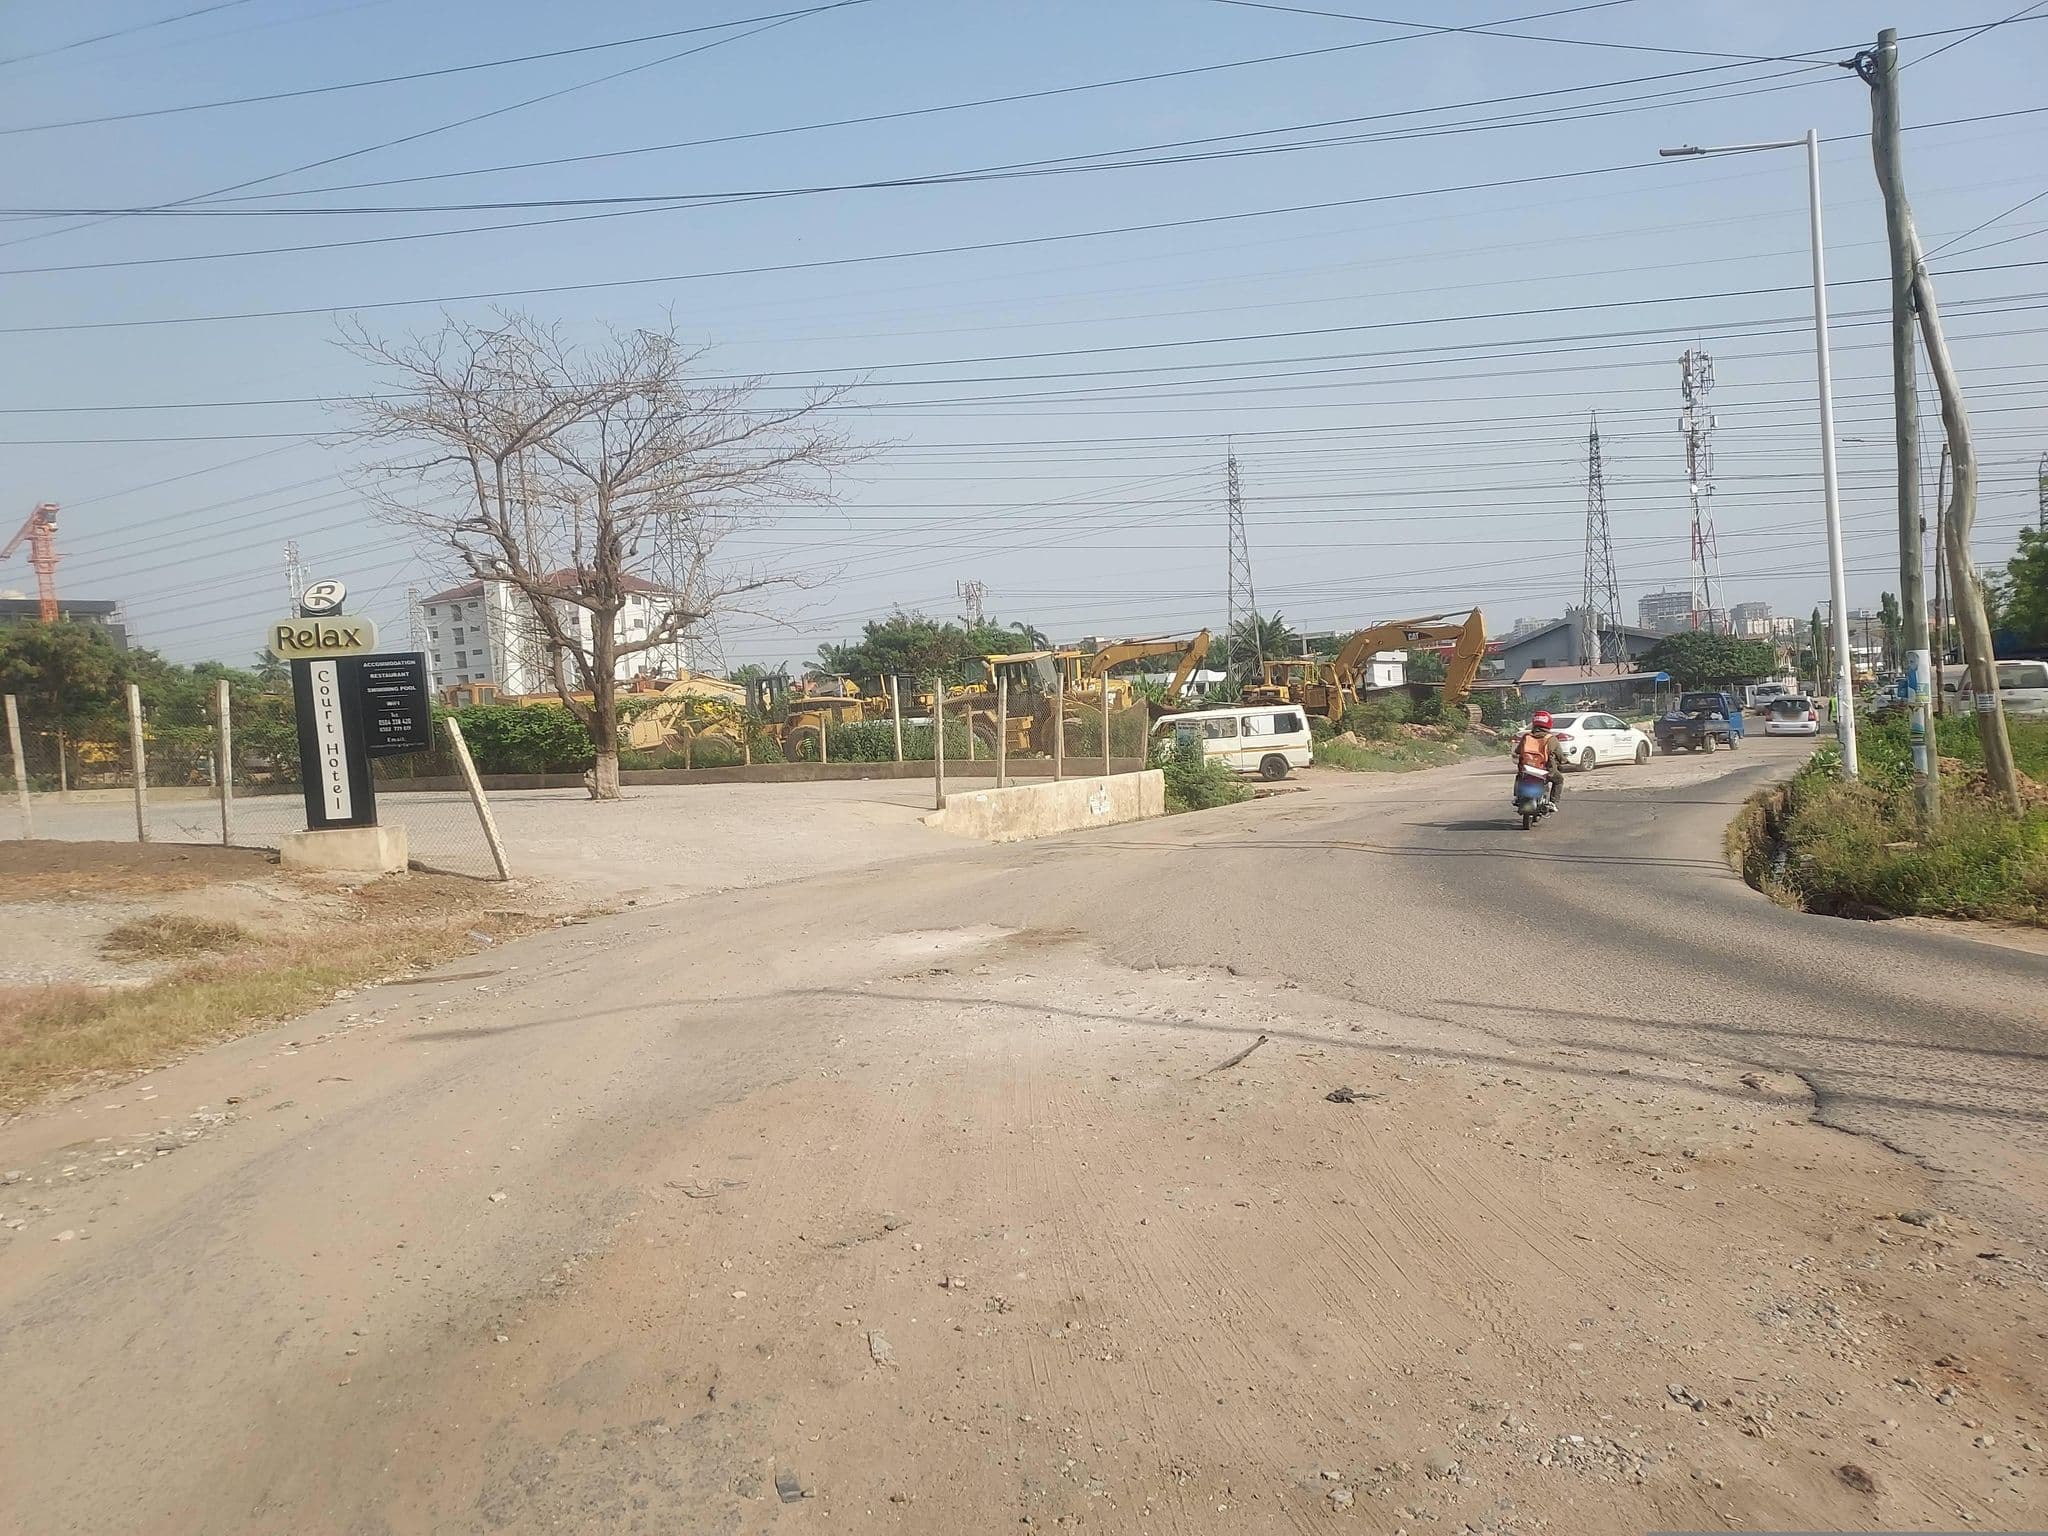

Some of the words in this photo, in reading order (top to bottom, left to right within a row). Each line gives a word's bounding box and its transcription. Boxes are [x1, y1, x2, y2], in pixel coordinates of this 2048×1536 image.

[306, 585, 337, 606] R
[276, 622, 362, 650] Relax
[318, 670, 334, 734] Court
[327, 743, 342, 810] Hotel
